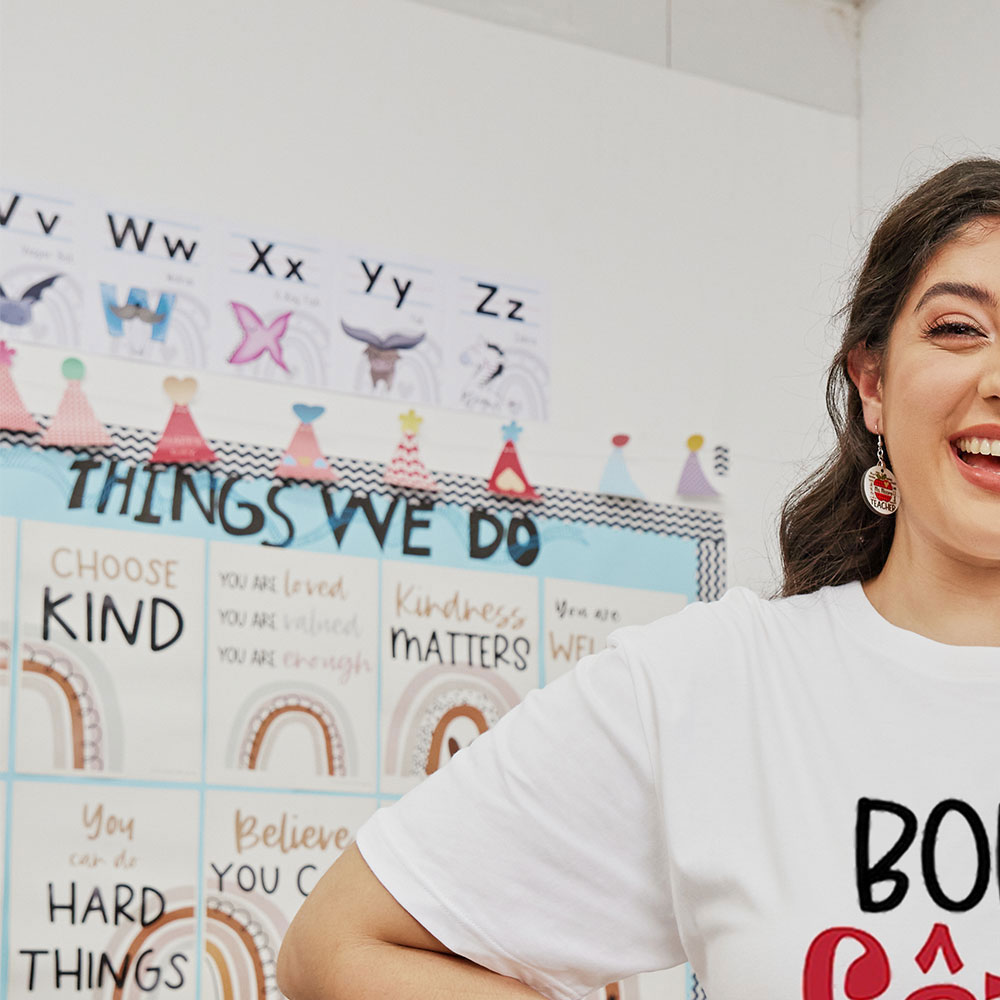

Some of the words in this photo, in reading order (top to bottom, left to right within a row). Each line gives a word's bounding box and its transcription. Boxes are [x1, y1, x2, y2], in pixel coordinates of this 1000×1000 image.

[68, 458, 295, 548] THINGS
[321, 485, 436, 557] WE
[469, 506, 541, 567] DO
[50, 547, 179, 589] CHOOSE
[219, 571, 248, 592] YOU
[252, 573, 276, 593] ARE
[283, 568, 346, 601] loved
[43, 586, 184, 651] KIND
[218, 608, 247, 629] YOU
[251, 612, 276, 630] ARE
[394, 582, 528, 630] Kindness
[217, 645, 247, 666] YOU
[251, 649, 276, 668] ARE
[282, 650, 373, 685] enough
[391, 626, 531, 672] MATTERS
[84, 804, 136, 840] You
[234, 809, 352, 854] Believe
[69, 851, 105, 868] can
[114, 850, 138, 868] do
[210, 863, 279, 894] YOU
[48, 881, 166, 928] HARD
[19, 947, 188, 991] THINGS
